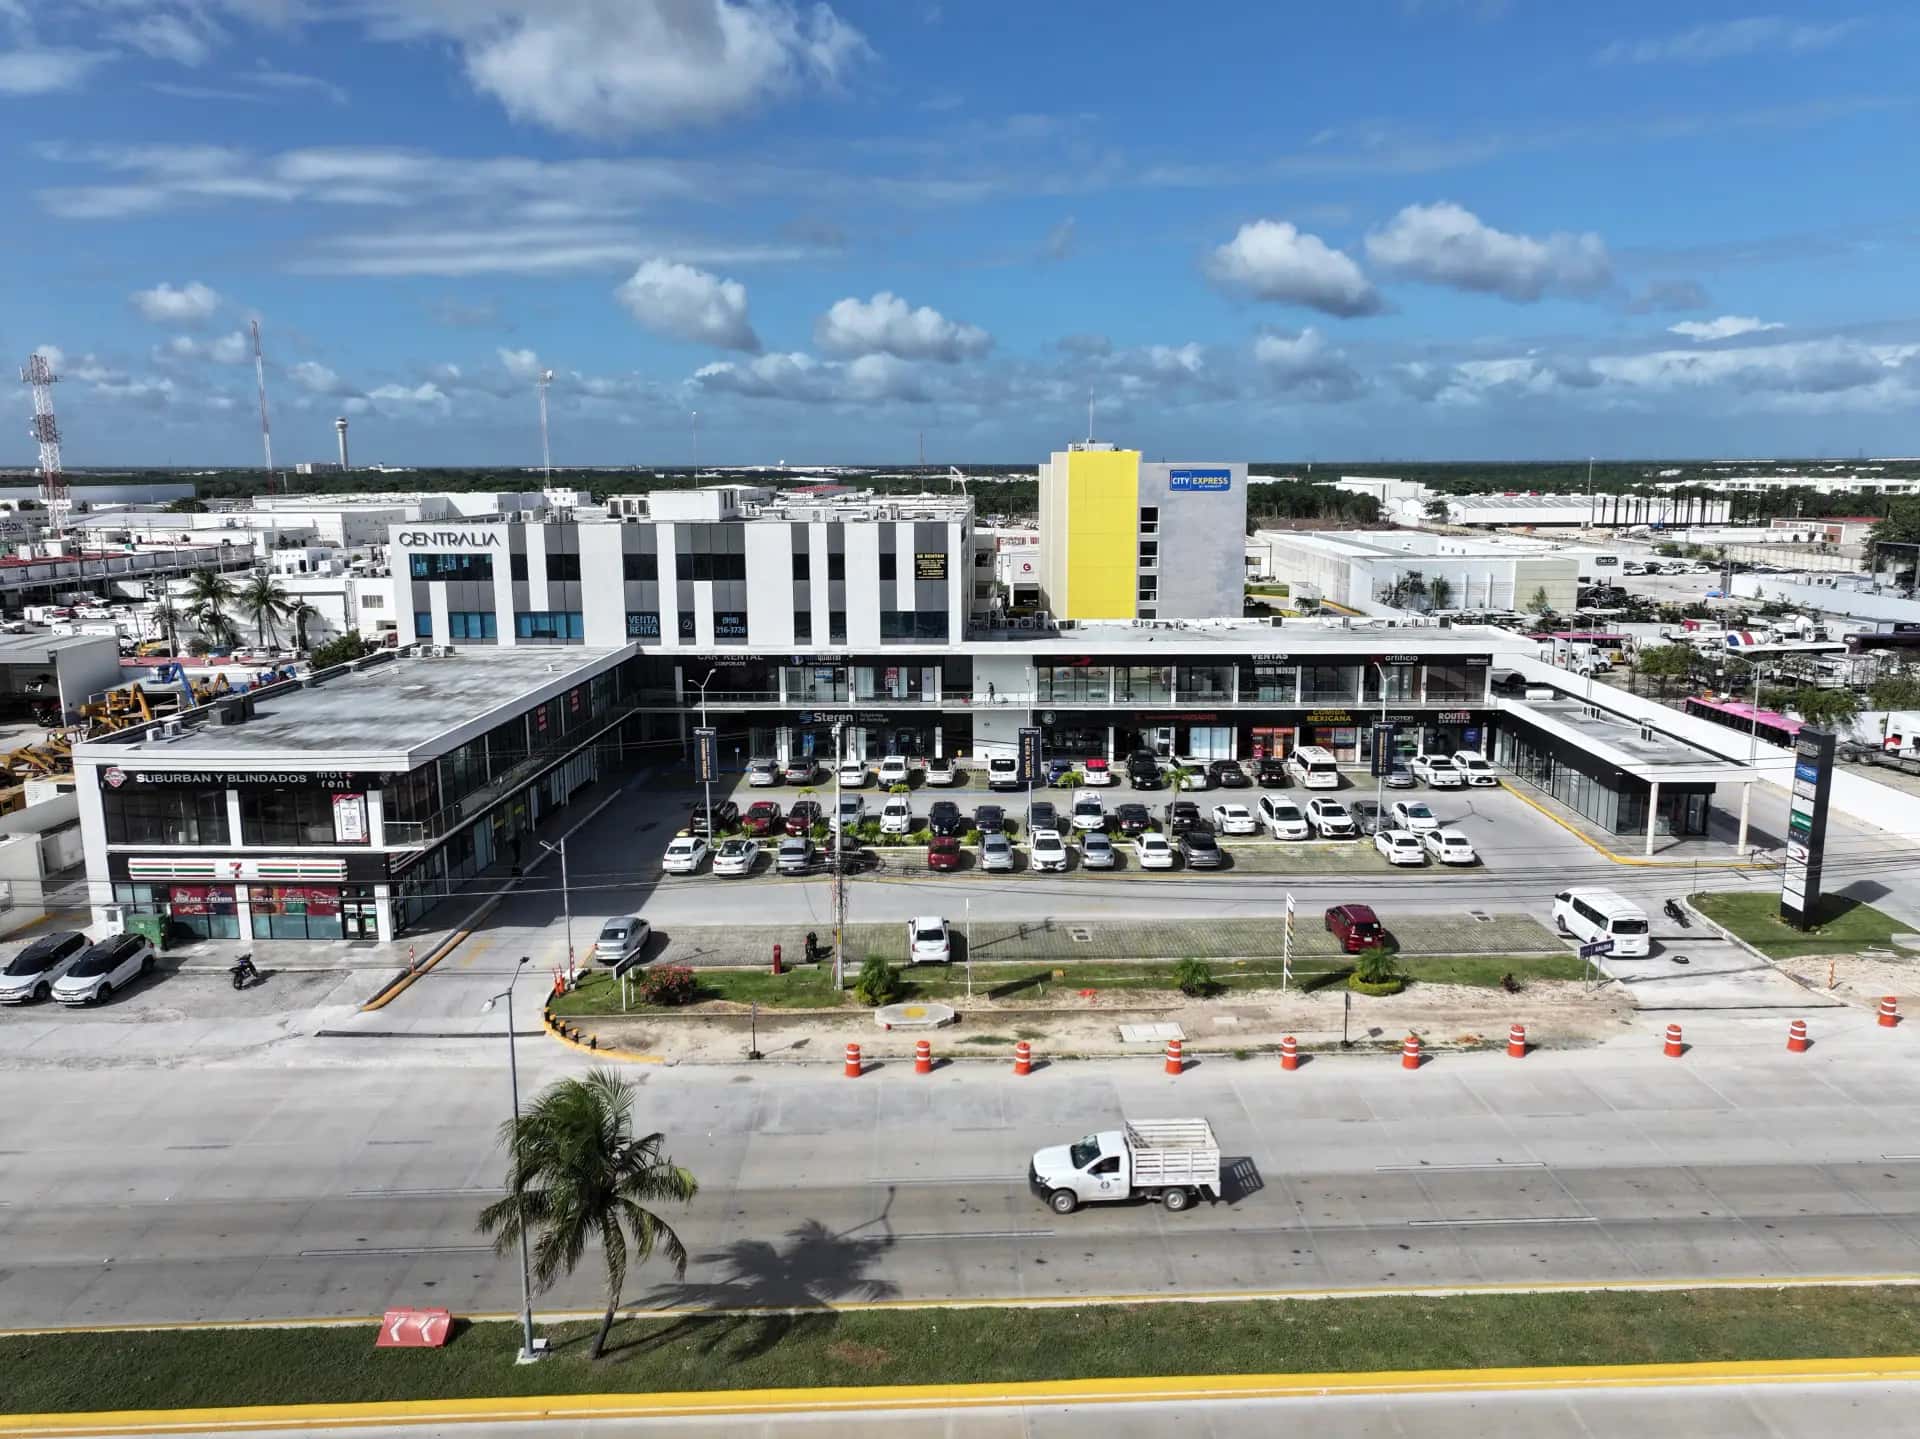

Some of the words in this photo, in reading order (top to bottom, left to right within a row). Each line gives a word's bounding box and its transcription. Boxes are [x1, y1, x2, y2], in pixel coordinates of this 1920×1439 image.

[1172, 477, 1190, 485] CITY
[1192, 477, 1229, 485] EXPRESS
[399, 532, 500, 547] CENTRALIA
[628, 616, 658, 625] VENTA
[629, 625, 659, 635] RENTA
[813, 712, 853, 722] Steren
[1438, 712, 1471, 720] ROUTES
[136, 773, 210, 783] SUBURBAN
[214, 774, 224, 783] Y
[227, 774, 307, 784] BLINDADOS
[321, 780, 352, 789] rent
